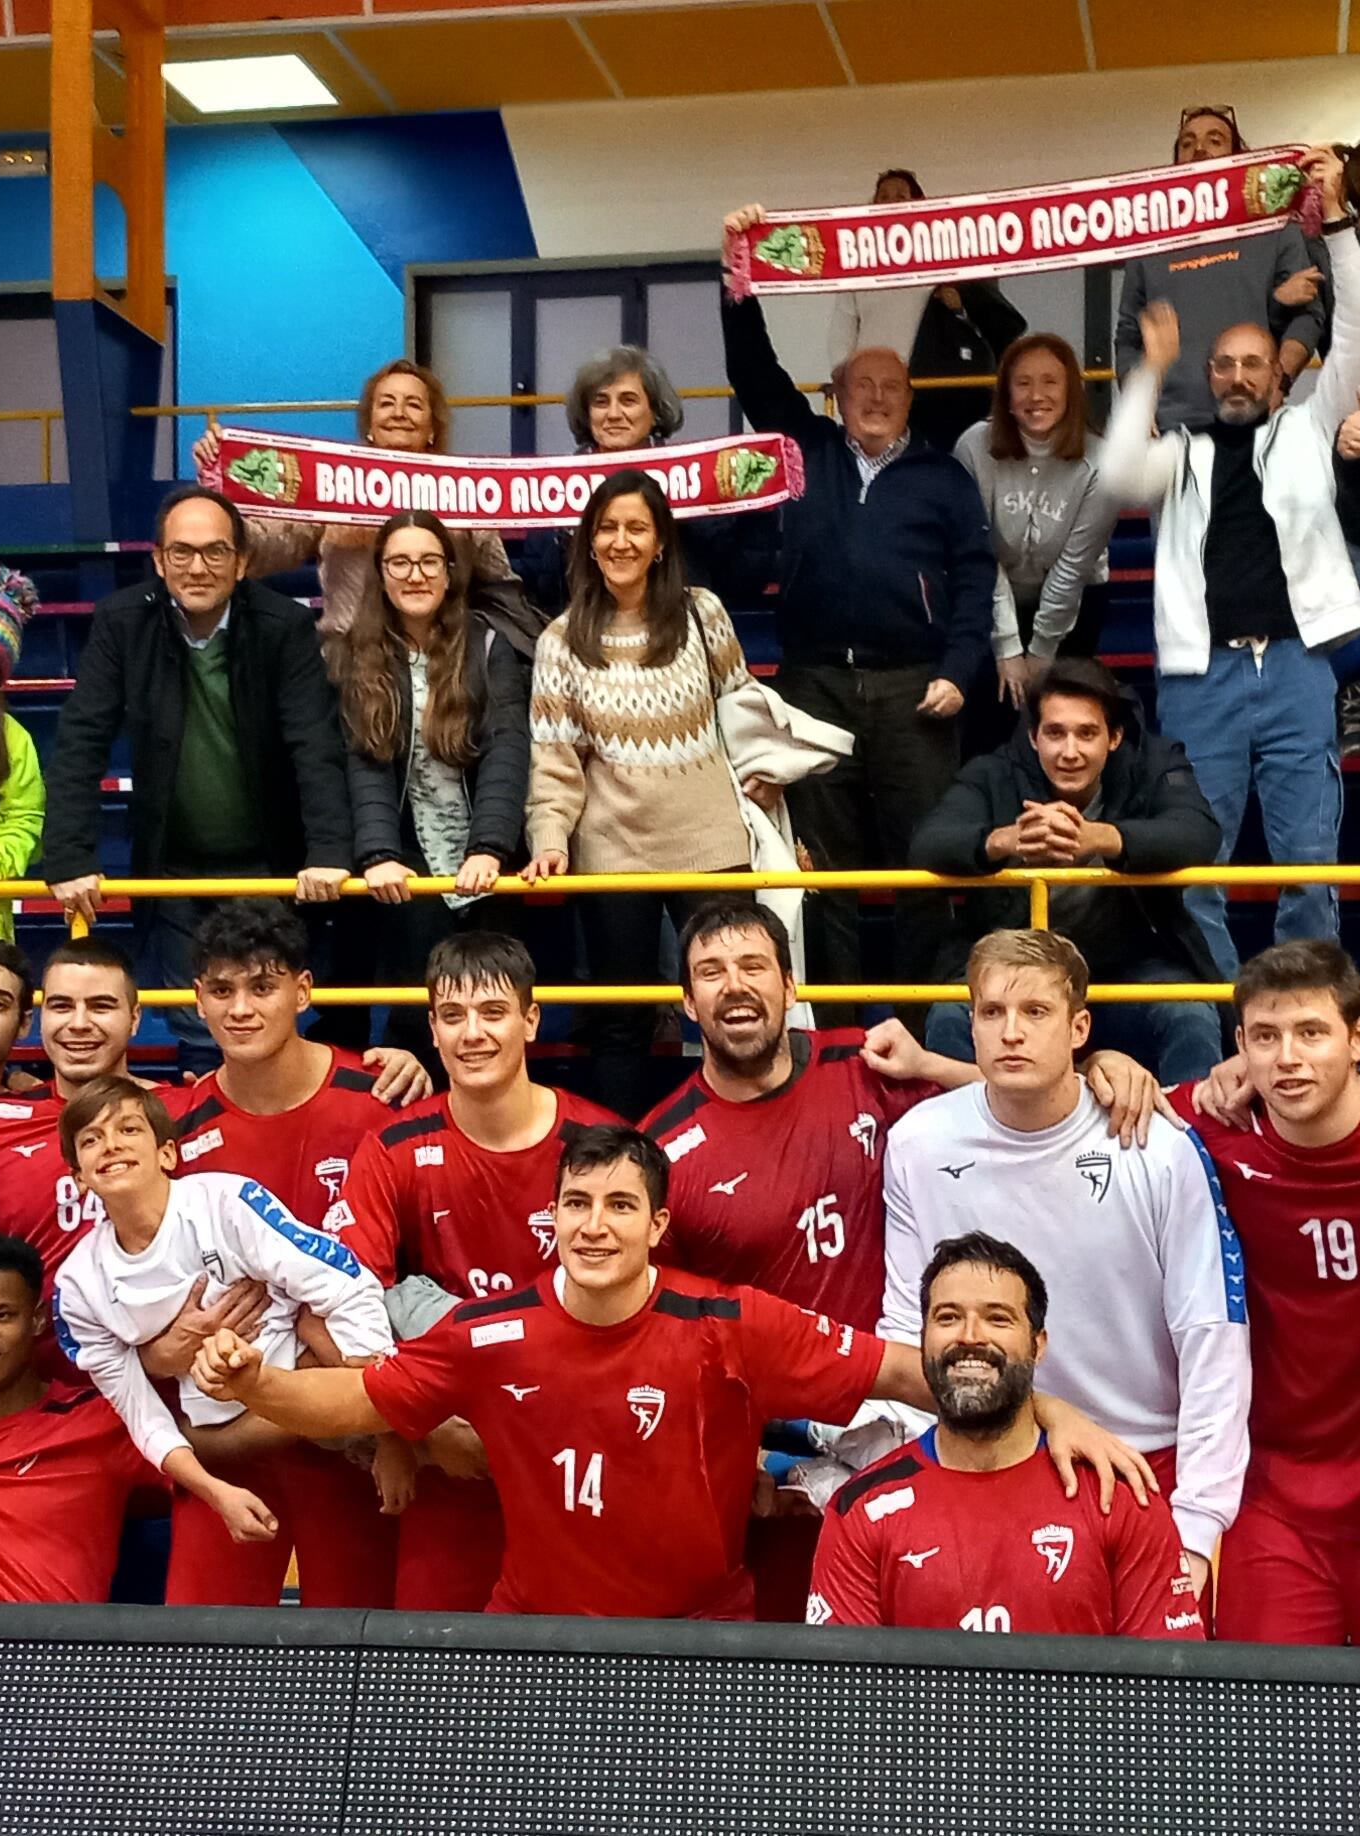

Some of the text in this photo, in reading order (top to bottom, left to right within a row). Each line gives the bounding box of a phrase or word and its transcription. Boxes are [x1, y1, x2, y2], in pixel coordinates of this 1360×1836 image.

[836, 178, 1229, 270] BALONMANO ALCOBENDAS
[315, 462, 503, 514] BALONMANO
[55, 1175, 107, 1232] 84
[796, 1193, 845, 1264] 15
[1298, 1218, 1359, 1281] 19
[552, 1448, 604, 1518] 14
